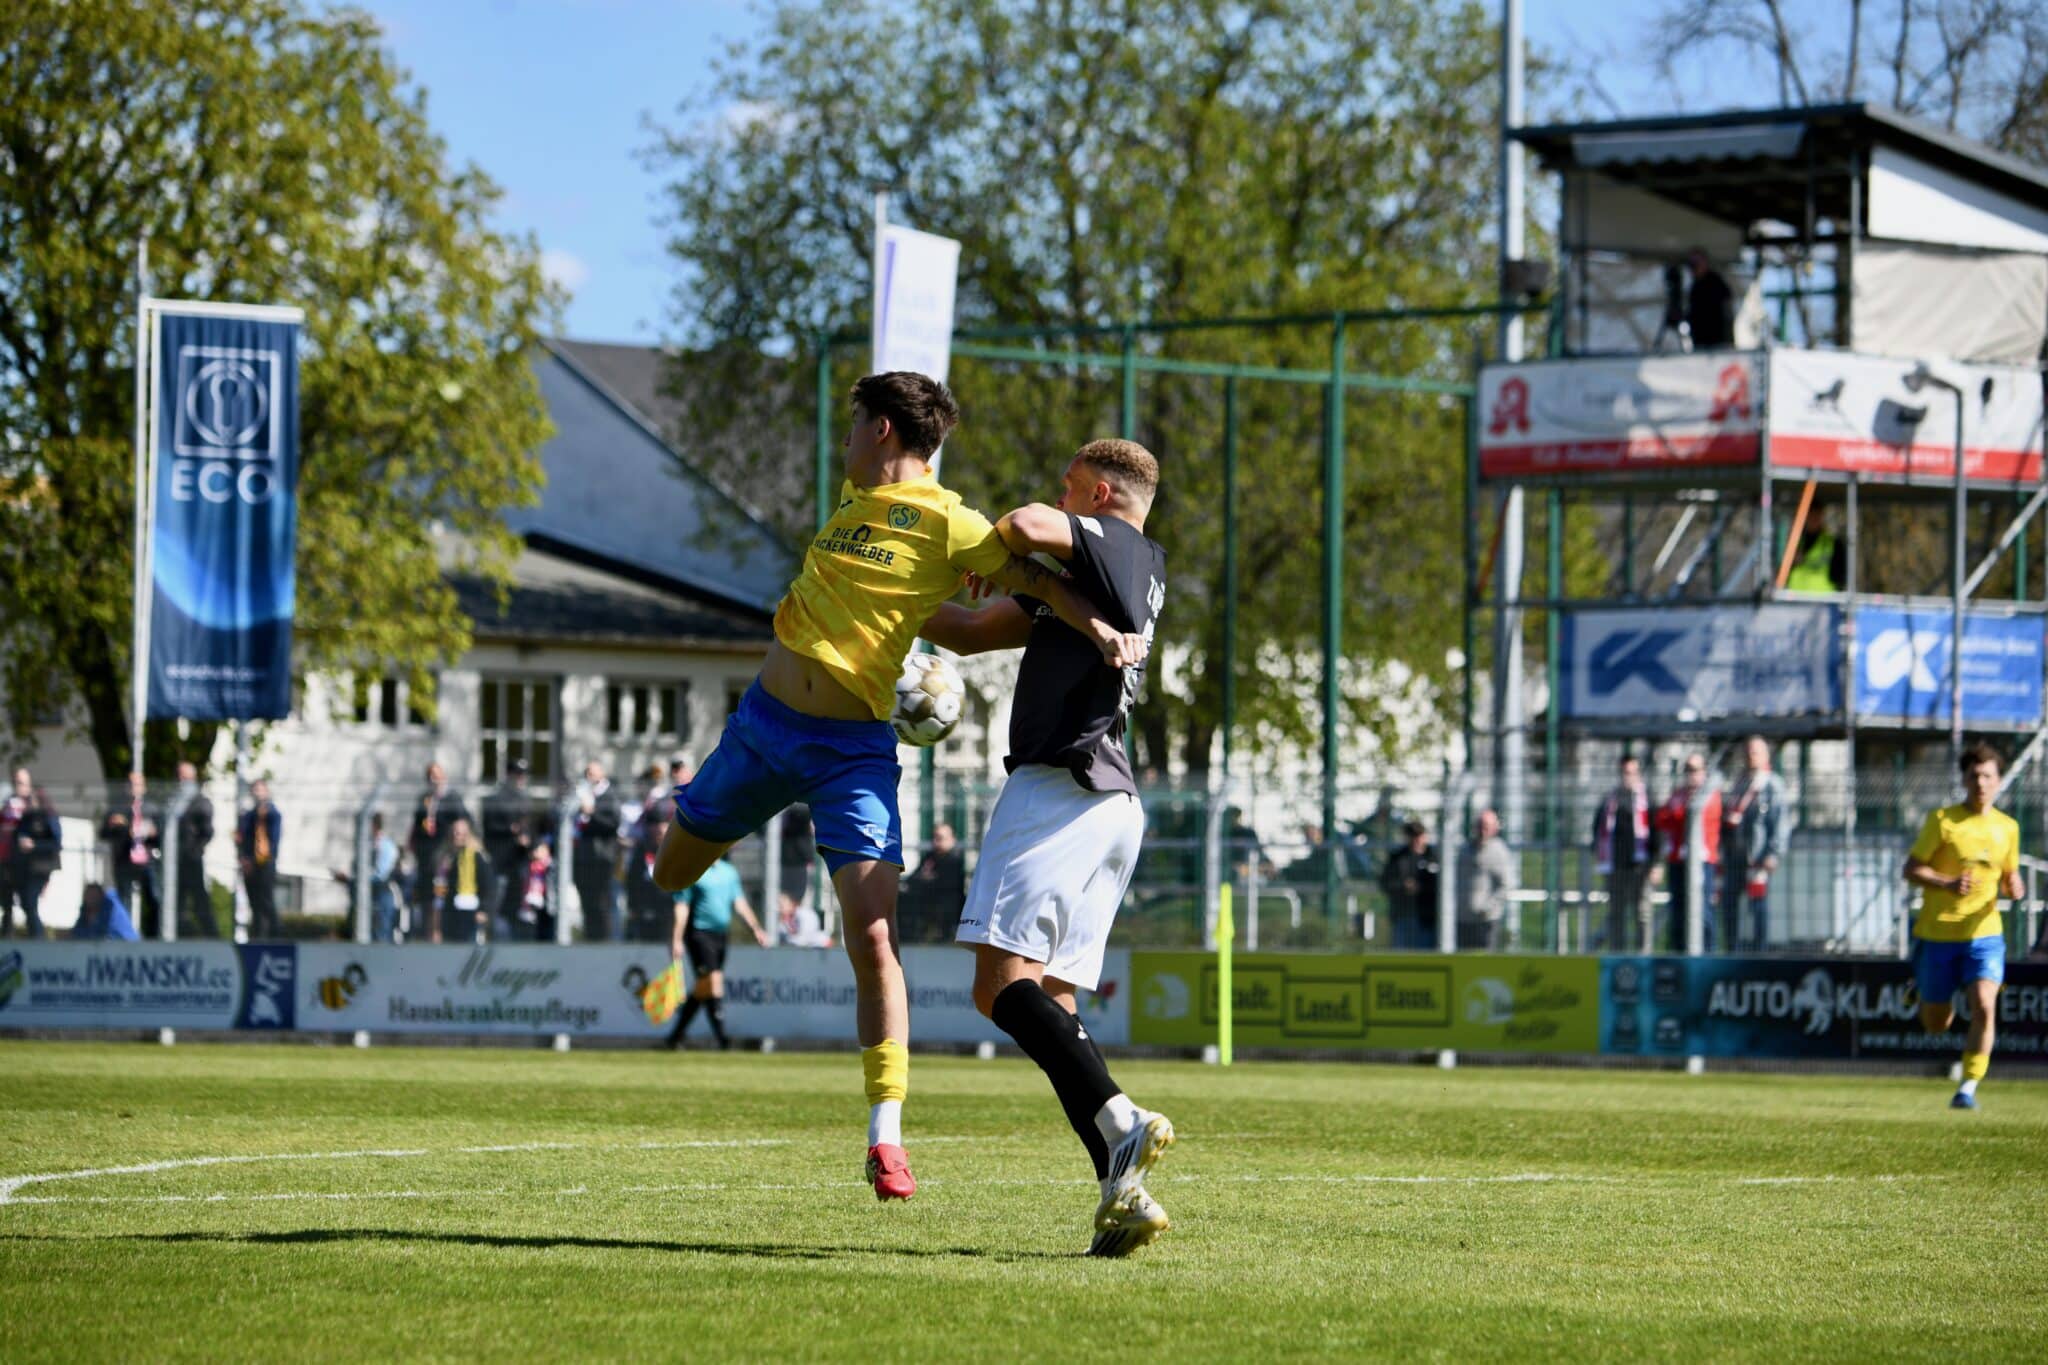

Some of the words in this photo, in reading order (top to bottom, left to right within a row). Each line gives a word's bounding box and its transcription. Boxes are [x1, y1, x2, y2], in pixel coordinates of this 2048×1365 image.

[171, 459, 275, 504] ECO
[832, 527, 853, 540] DIE
[388, 995, 599, 1031] Hauskrankenpflege
[1707, 980, 1792, 1018] AUTO
